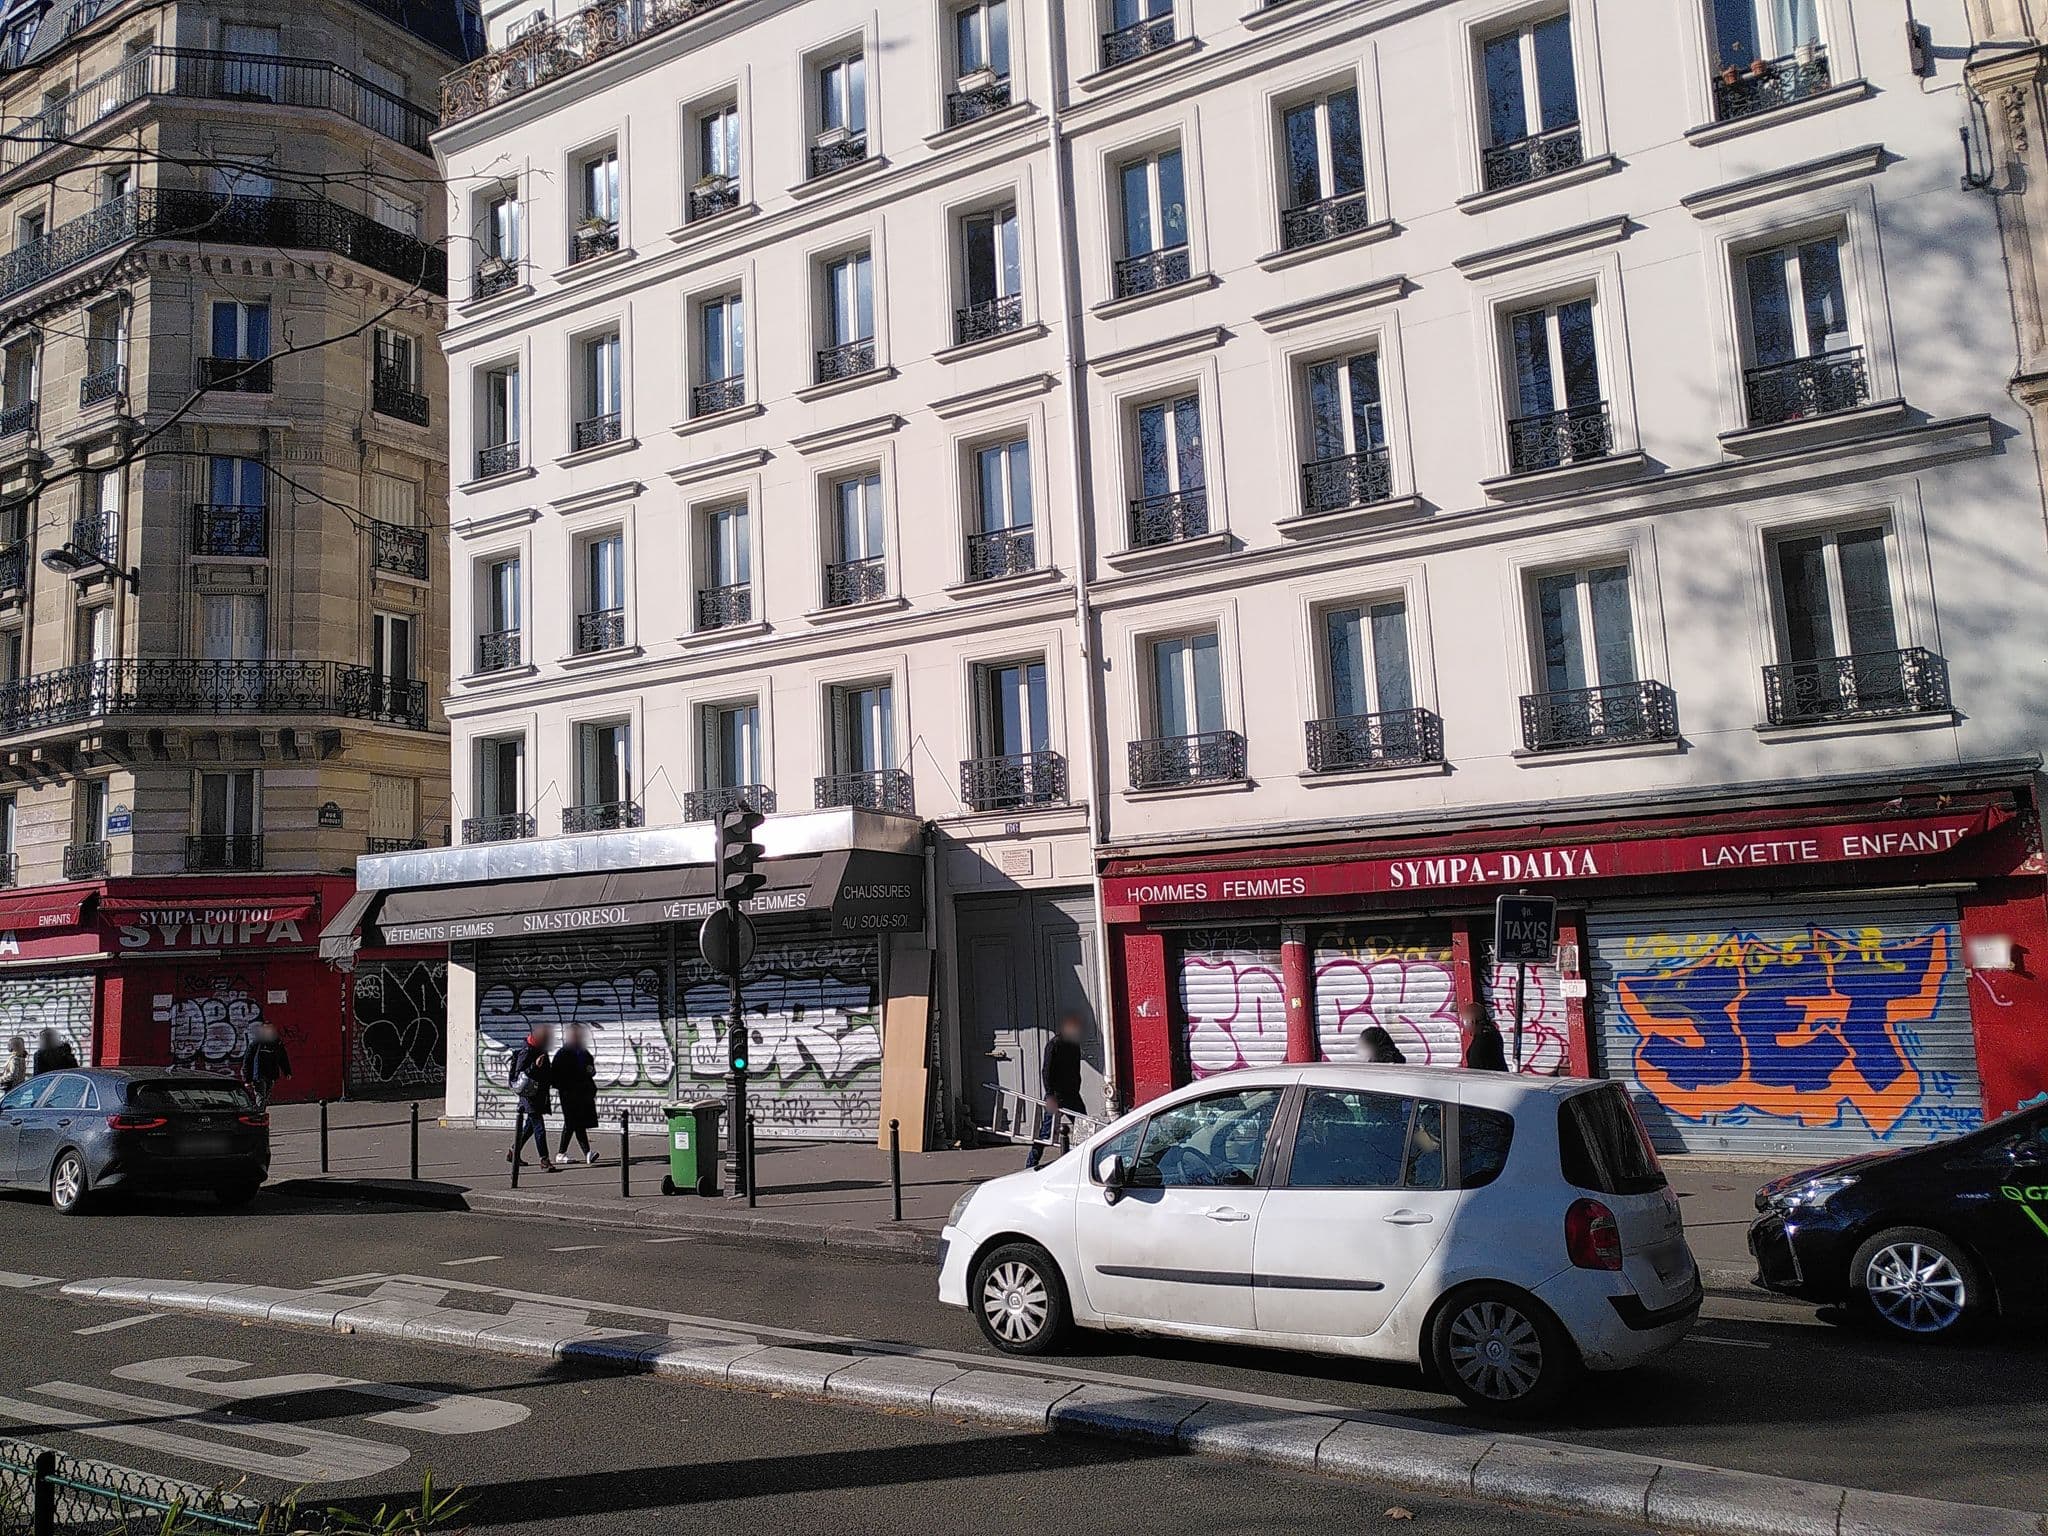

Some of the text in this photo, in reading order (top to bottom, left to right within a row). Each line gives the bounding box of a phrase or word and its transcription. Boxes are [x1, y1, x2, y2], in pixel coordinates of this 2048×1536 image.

[1006, 823, 1019, 833] 66
[1702, 839, 1818, 867] LAYETTE
[1389, 848, 1600, 889] SYMPA-DALYA
[843, 884, 911, 900] CHAUSSURES
[1127, 876, 1306, 904] HOMMES FEMMES
[663, 893, 807, 919] VÊTEMENS FEMMES
[38, 913, 71, 926] ENFANTS
[139, 908, 275, 926] SYMPA-POUTOU
[522, 905, 630, 932] SIM-STORESOL
[842, 915, 857, 930] AU
[119, 920, 304, 948] SYMPA
[384, 922, 495, 943] VÊTEMENTS FEMMES
[1504, 920, 1548, 941] TAXIS
